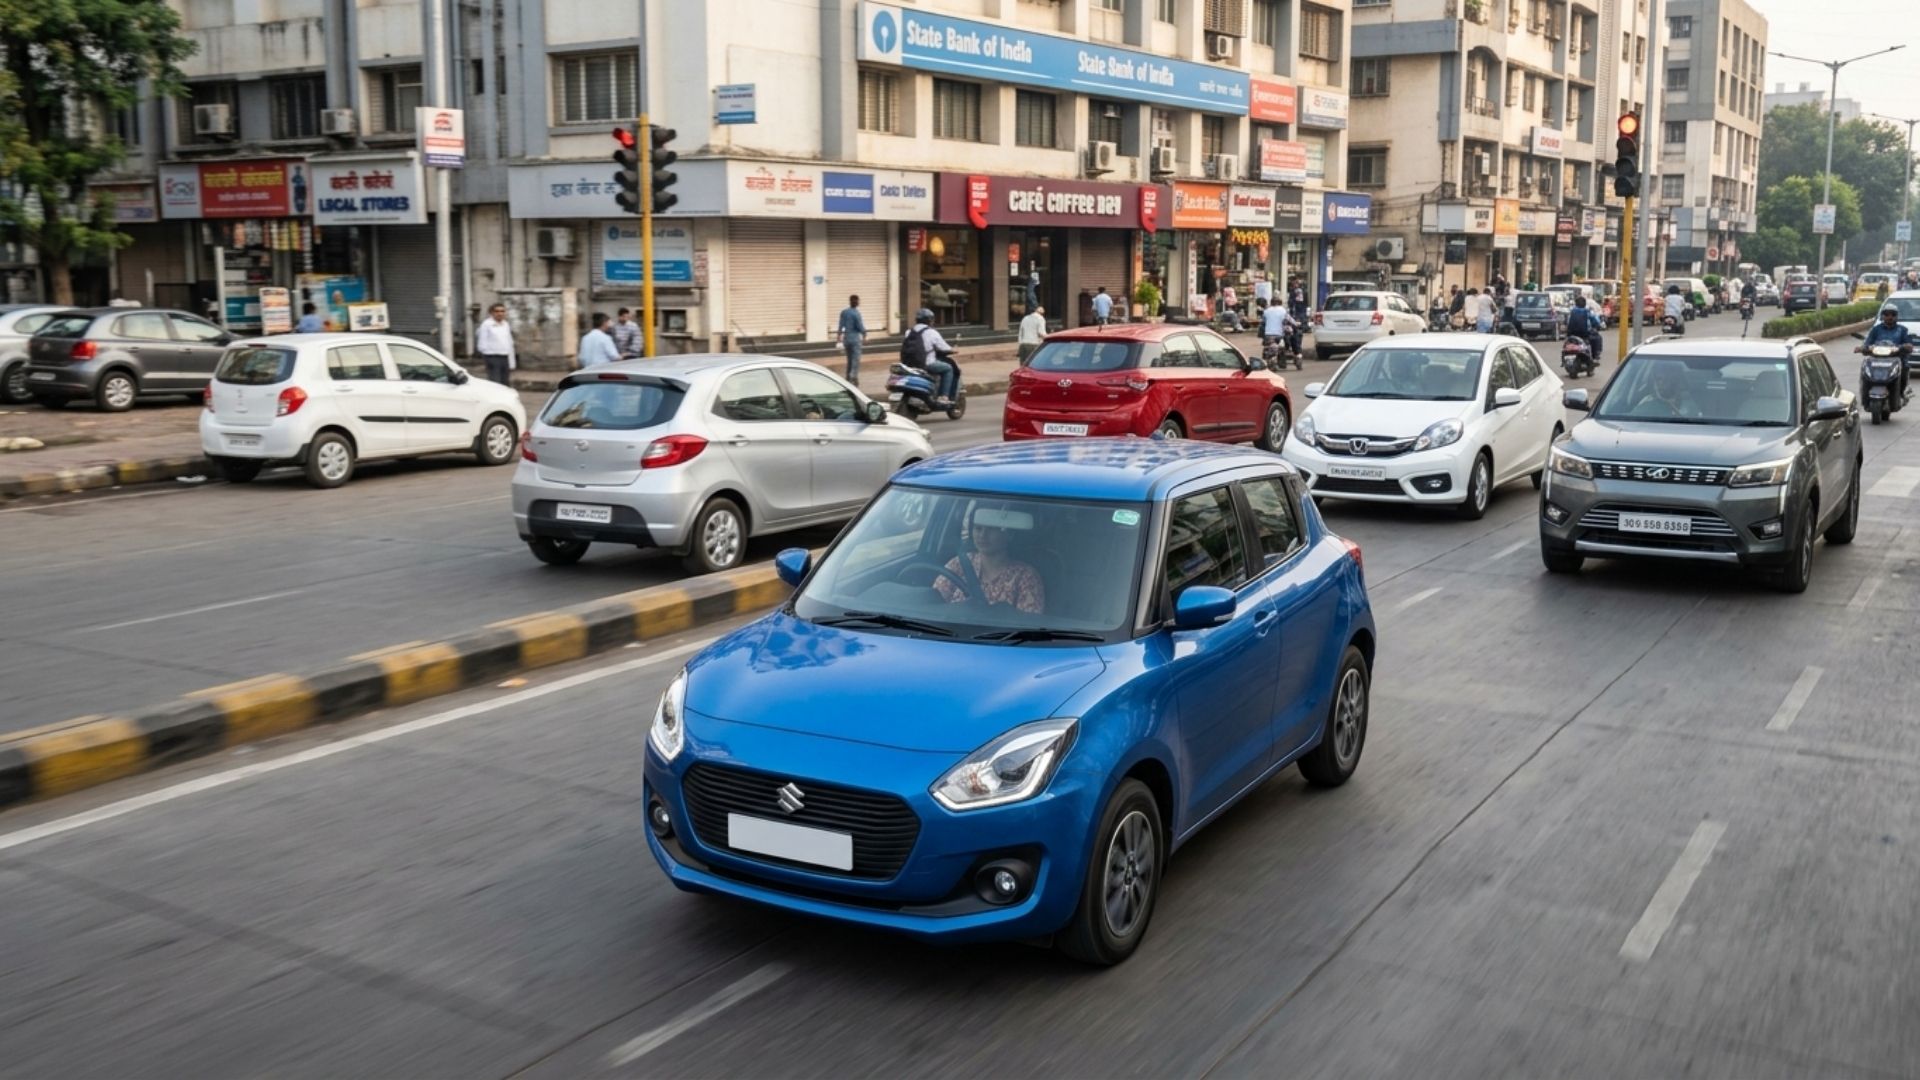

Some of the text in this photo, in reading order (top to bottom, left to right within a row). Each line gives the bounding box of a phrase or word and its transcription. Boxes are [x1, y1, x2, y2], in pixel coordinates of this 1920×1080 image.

[906, 19, 1033, 64] State Bank of India
